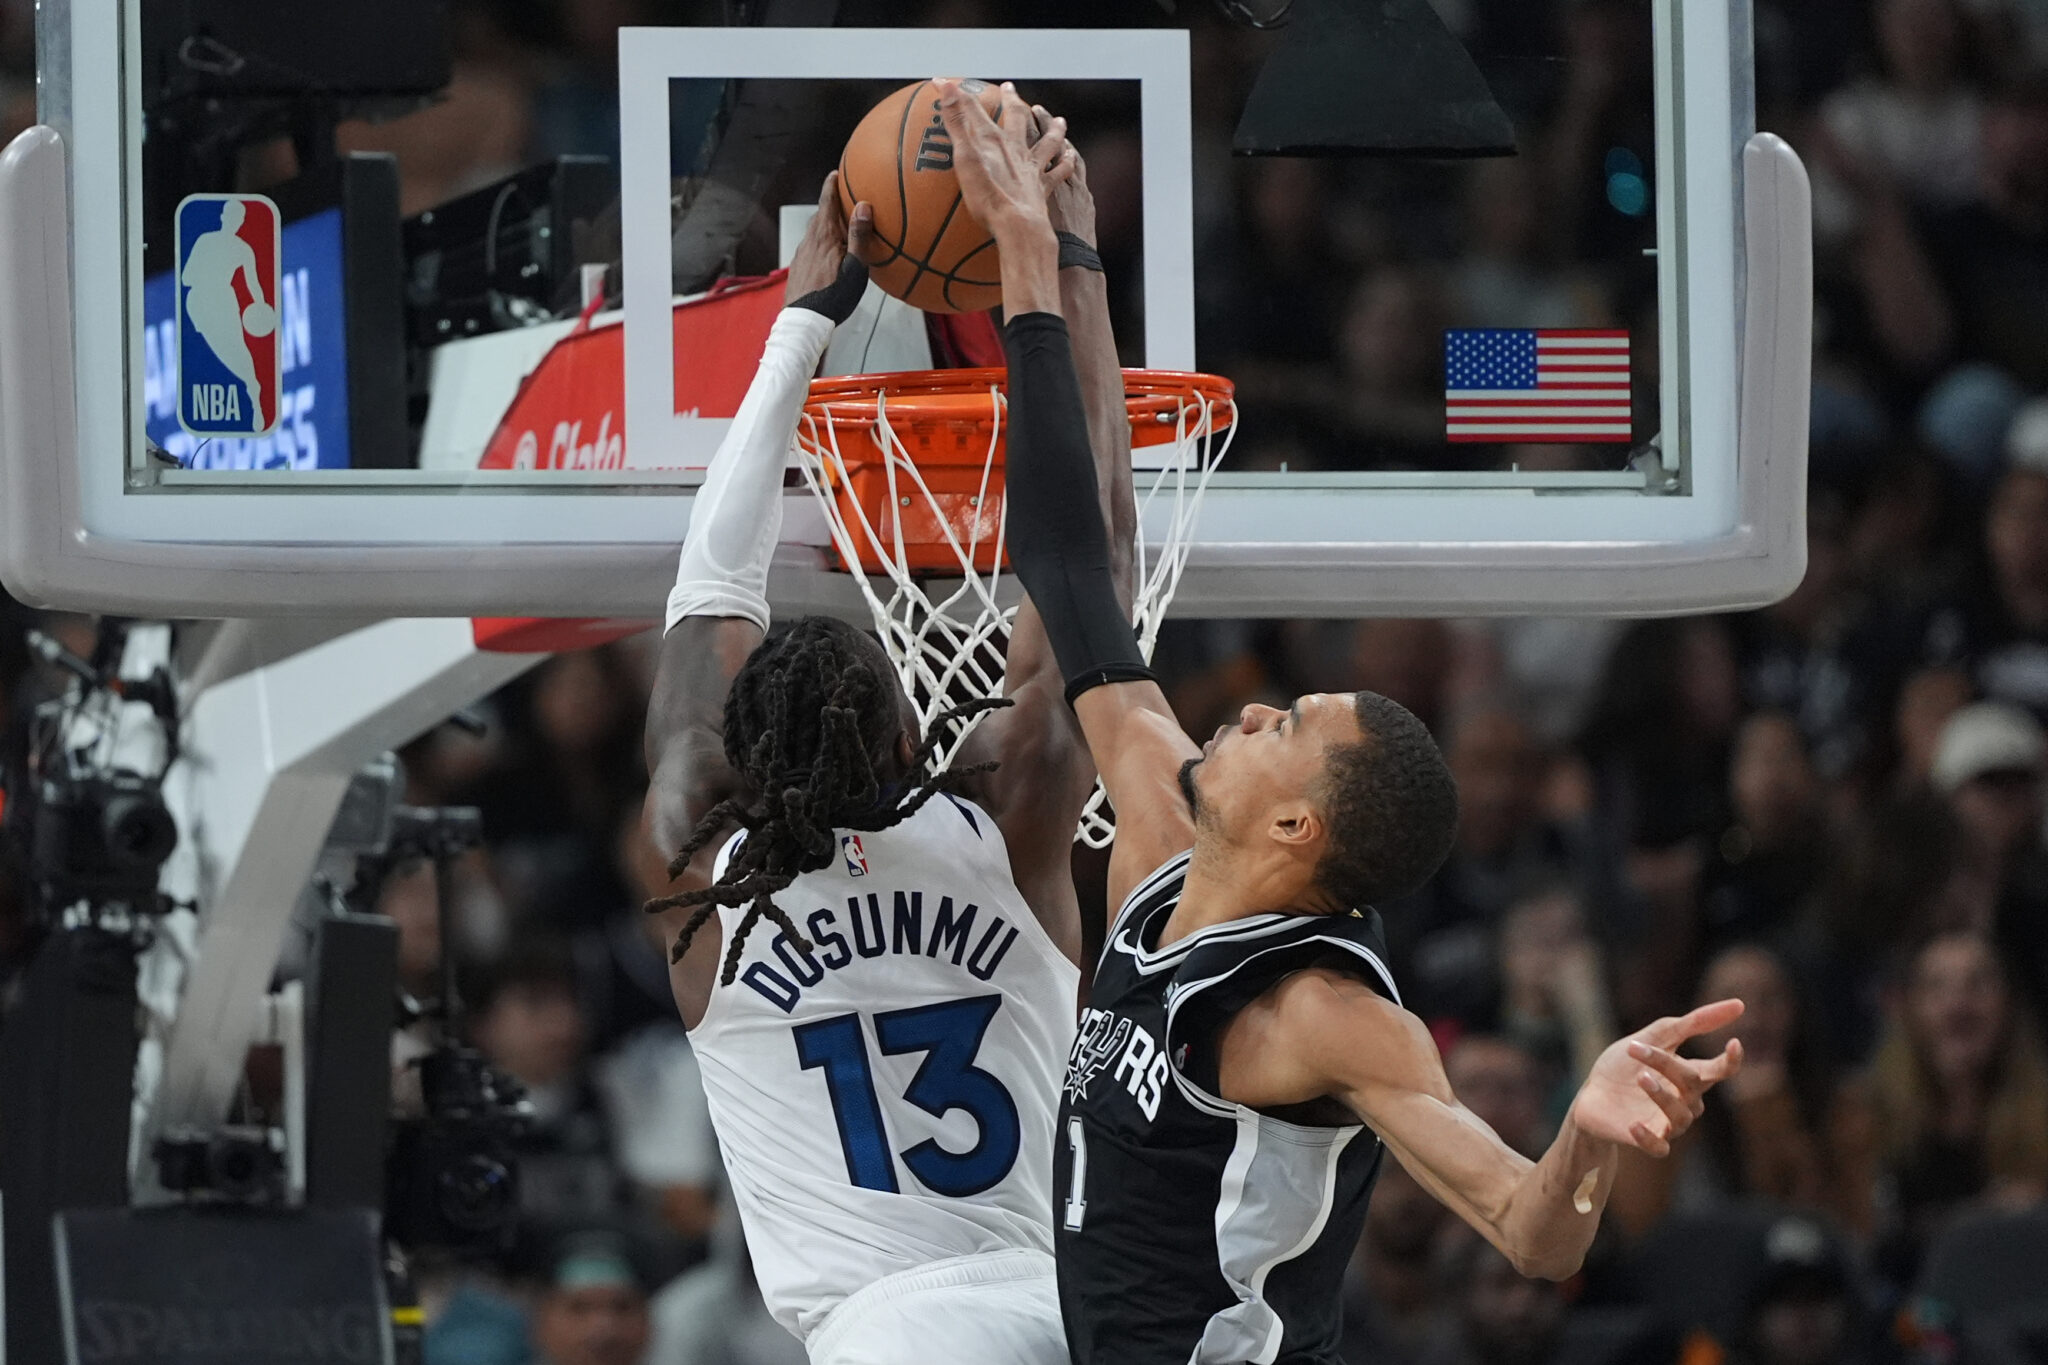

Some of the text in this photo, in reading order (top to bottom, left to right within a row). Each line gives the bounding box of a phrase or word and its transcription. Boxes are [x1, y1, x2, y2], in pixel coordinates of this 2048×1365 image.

[193, 384, 241, 421] NBA
[740, 891, 1019, 1014] DOSUNMU
[792, 994, 1021, 1198] 13
[1066, 1008, 1169, 1123] PURS
[1064, 1115, 1088, 1232] 1
